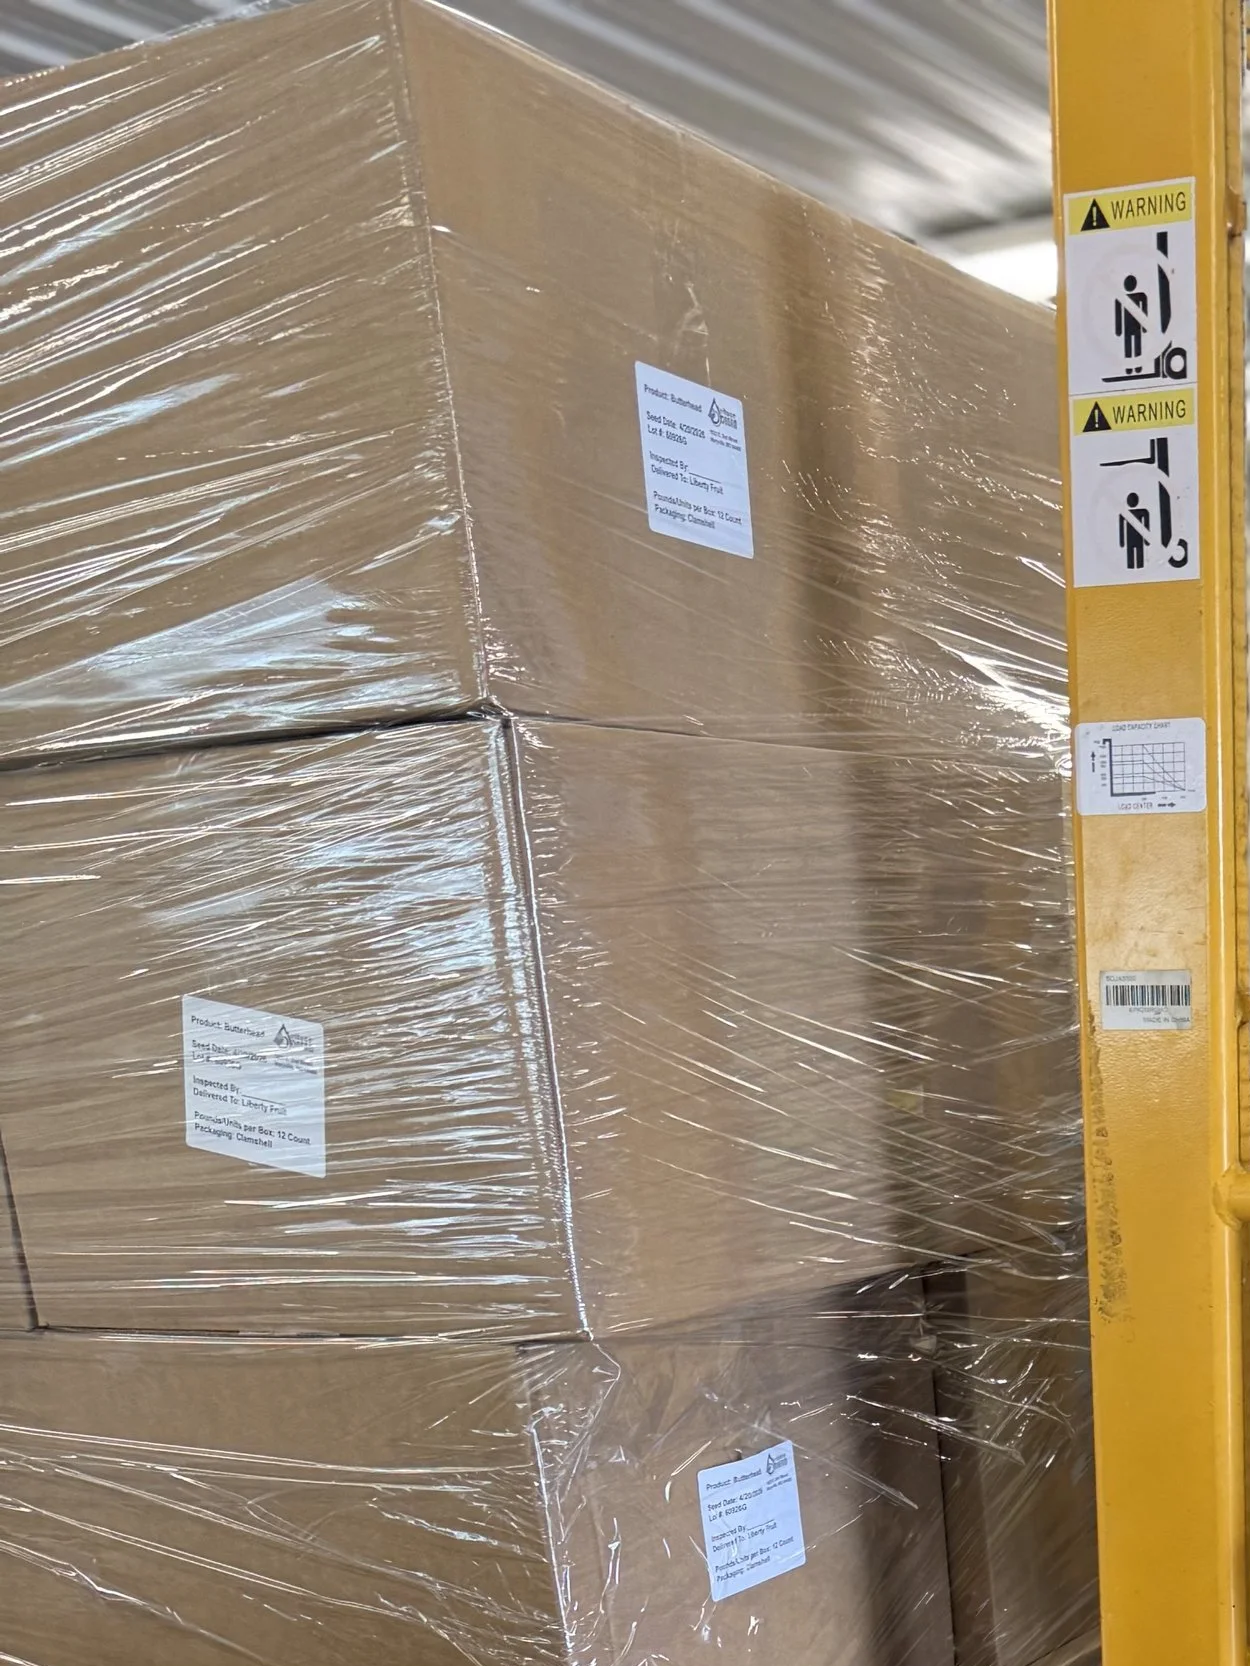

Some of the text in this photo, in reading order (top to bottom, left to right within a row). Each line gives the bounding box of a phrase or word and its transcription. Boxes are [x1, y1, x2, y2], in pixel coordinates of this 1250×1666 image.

[1111, 191, 1186, 220] WARNING
[1112, 399, 1186, 424] WARNING
[649, 451, 678, 468] Inspected
[689, 477, 709, 491] Liberty
[693, 505, 701, 513] per
[717, 510, 723, 519] 12
[193, 1075, 228, 1091] Inspected
[193, 1087, 227, 1102] Delivered
[242, 1099, 267, 1112] Liberty
[236, 1132, 272, 1148] Clamshell
[243, 1124, 256, 1133] per
[278, 1131, 285, 1139] 12
[287, 1133, 310, 1145] Count
